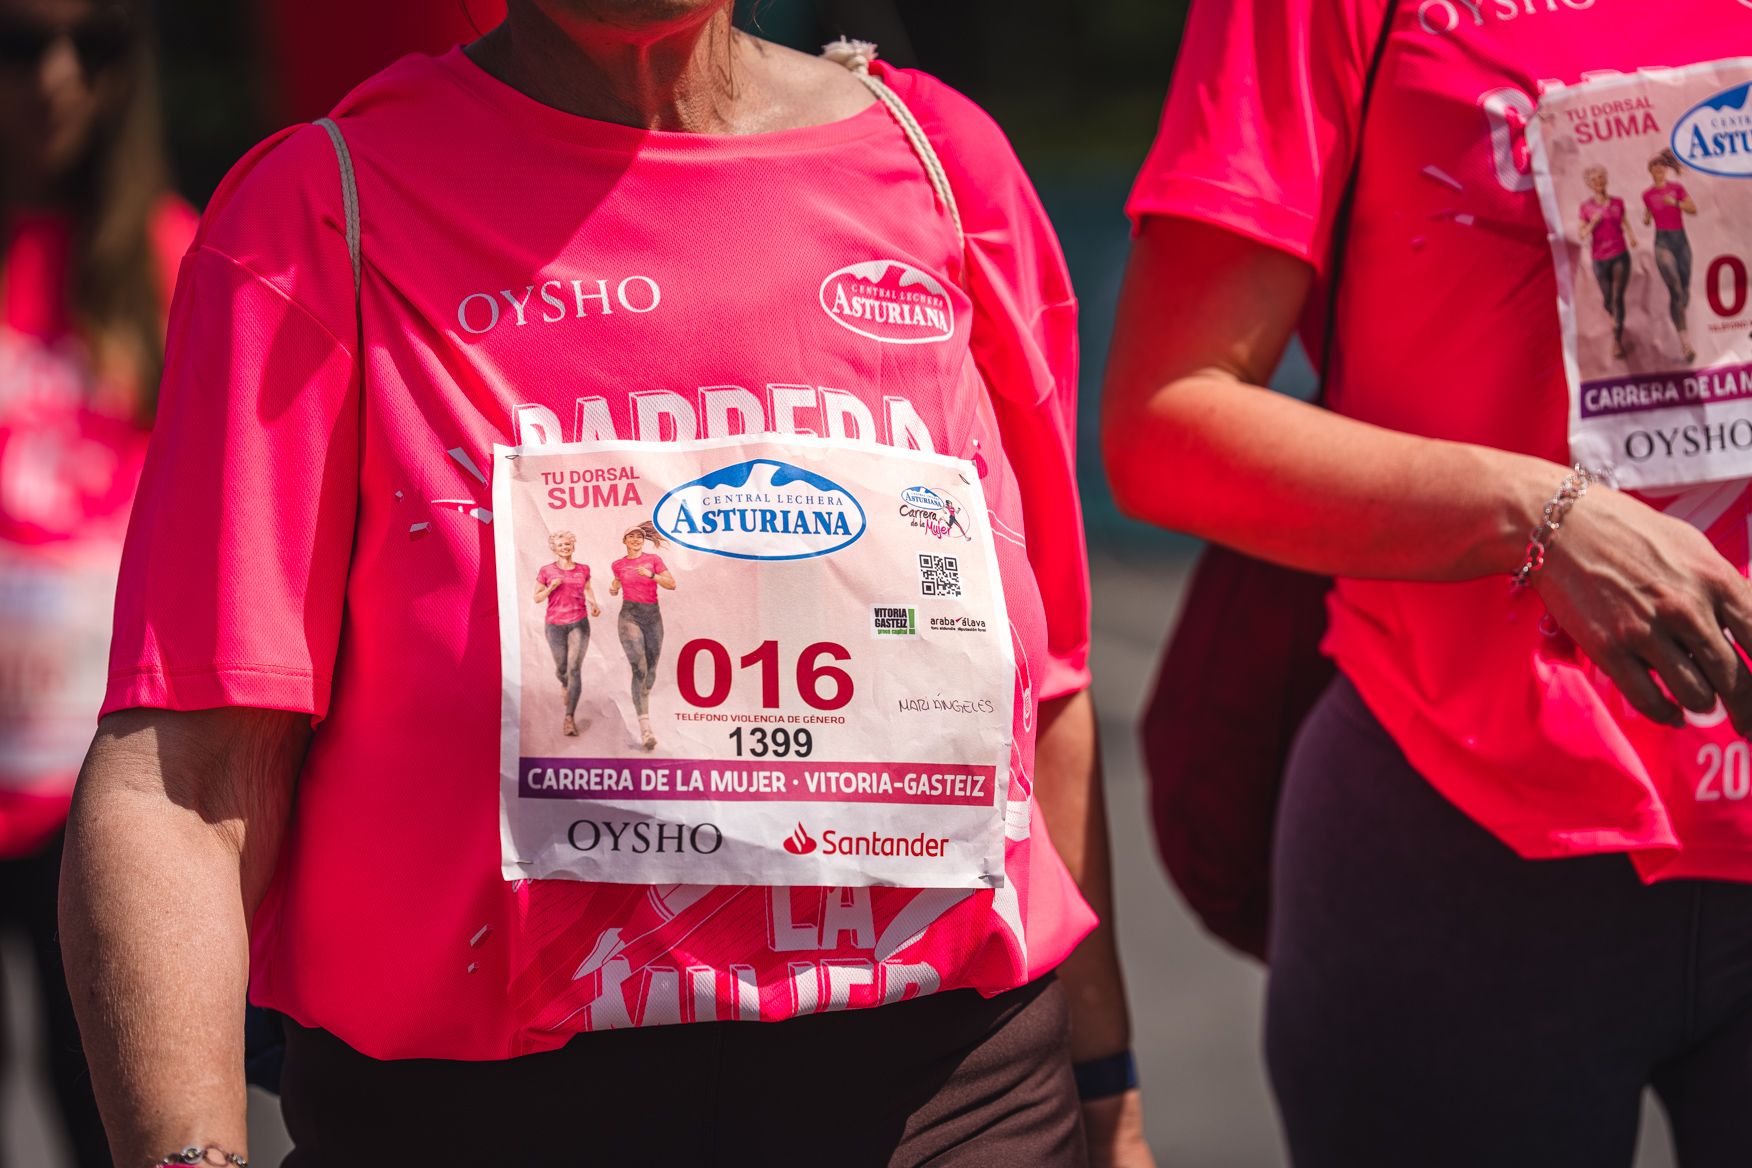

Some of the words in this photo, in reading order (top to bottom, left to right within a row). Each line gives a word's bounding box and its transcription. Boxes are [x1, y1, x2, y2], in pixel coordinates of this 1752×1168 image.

[1567, 107, 1589, 123] TU
[1590, 95, 1654, 117] DORSAL
[1574, 111, 1661, 145] SUMA
[457, 275, 661, 334] OYSHO
[832, 282, 949, 333] ASTURIANA
[851, 284, 897, 300] CENTRAL
[899, 291, 944, 307] LECHERA
[1584, 380, 1680, 412] CARRERA
[1684, 375, 1711, 400] DE
[1713, 370, 1738, 396] LA
[541, 472, 564, 486] TU
[570, 466, 640, 484] DORSAL
[547, 482, 643, 510] SUMA
[702, 493, 771, 506] CENTRAL
[777, 493, 843, 506] LECHERA
[905, 492, 942, 507] ASTURIANA
[671, 499, 852, 536] ASTURIANA
[899, 504, 938, 521] Carrera
[925, 518, 950, 540] Mujer
[874, 608, 908, 618] VITORIA
[874, 618, 908, 629] GASTEIZ
[930, 616, 955, 626] araba
[961, 616, 986, 628] álava
[676, 638, 855, 711] 016
[675, 711, 728, 722] TELÉFONO
[731, 714, 785, 723] VIOLENCIA
[787, 715, 800, 724] DE
[803, 713, 846, 725] GÉNERO
[729, 727, 813, 758] 1399
[527, 768, 634, 792] CARRERA
[640, 769, 669, 791] DE
[676, 769, 704, 792] LA
[710, 770, 787, 793] MUJER
[804, 771, 986, 797] VITORIA-GASTEIZ
[567, 819, 723, 855] OYSHO
[822, 829, 950, 857] Santander
